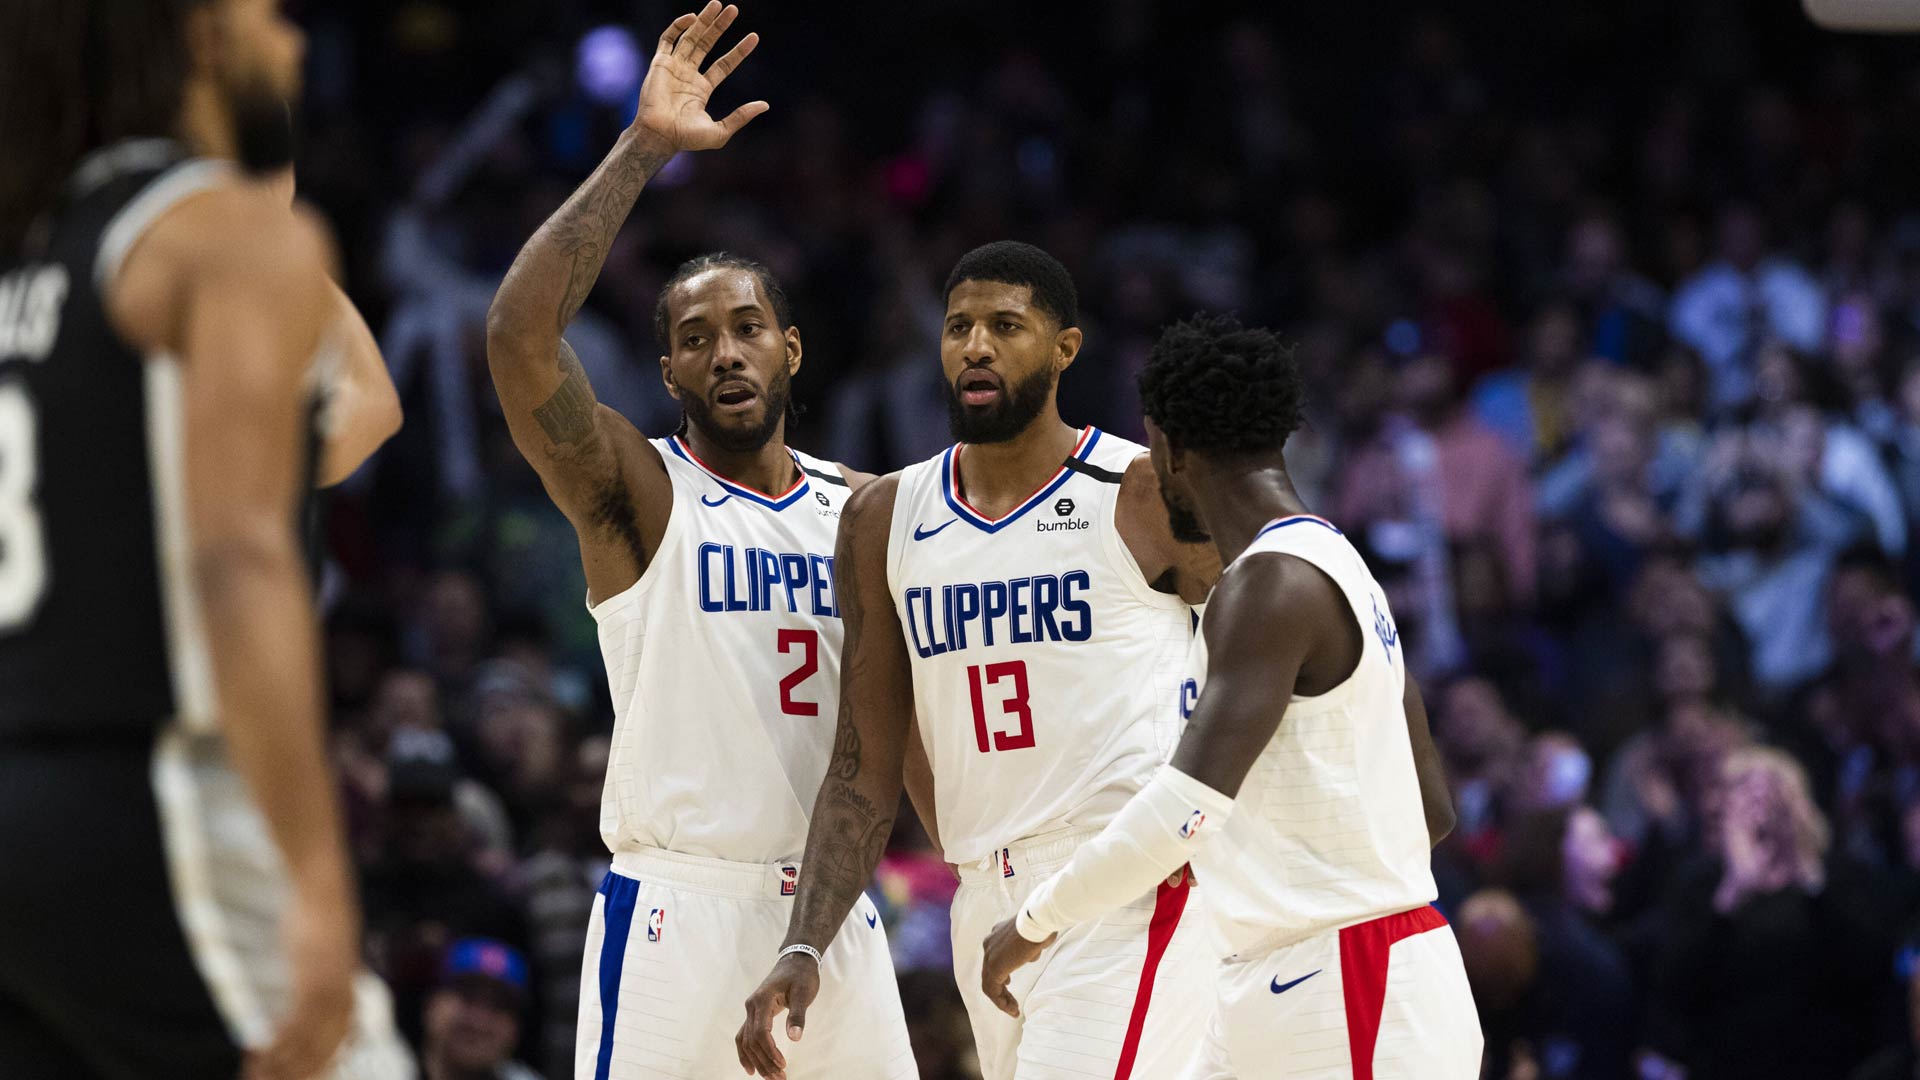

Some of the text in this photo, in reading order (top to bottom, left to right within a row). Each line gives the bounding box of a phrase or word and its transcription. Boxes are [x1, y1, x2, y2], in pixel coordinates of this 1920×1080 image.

[1036, 518, 1090, 532] bumble
[905, 569, 1092, 658] CLIPPERS
[777, 628, 819, 717] 2
[967, 659, 1036, 753] 13
